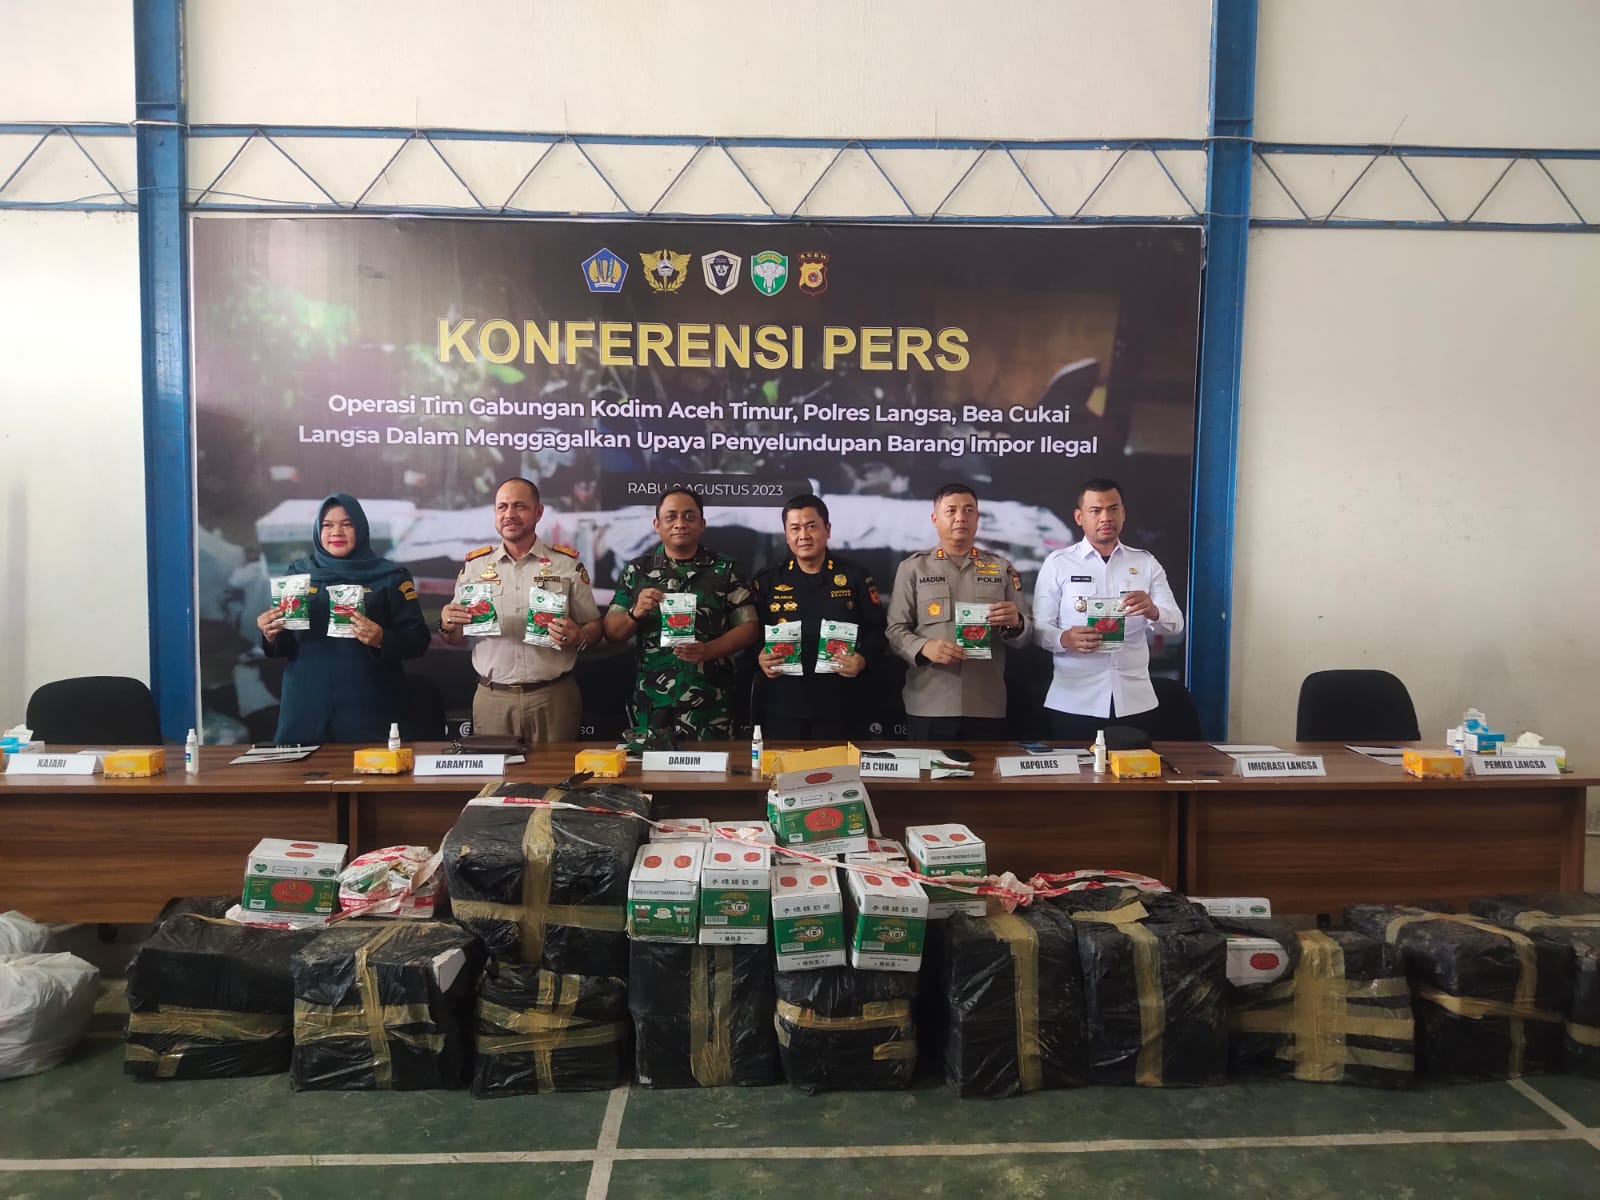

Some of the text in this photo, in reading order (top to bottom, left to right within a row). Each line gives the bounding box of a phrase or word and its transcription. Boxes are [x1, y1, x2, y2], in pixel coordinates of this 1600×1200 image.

[437, 317, 970, 372] KONFERENSI PERS
[328, 394, 1070, 425] Operasi Tim Gabungan Kodim Aceh Timur, Polres Langsa, Bea Cukai
[299, 425, 1098, 458] Langsa Dalam Menggagalkan Upaya Penyelundupan Barang Impor Ilegal
[752, 484, 784, 496] 2023
[919, 576, 946, 584] MADUN
[976, 576, 1003, 584] POLRI
[37, 758, 67, 768] KAJARI
[434, 759, 484, 770] KARANTINA
[668, 756, 701, 766] DANDIM
[1020, 760, 1059, 770] KAPOLRES
[1247, 760, 1319, 772] IMIGRASI LANGSA
[1484, 760, 1547, 769] PEMKO LANGSA
[861, 762, 898, 772] EA CUKAI
